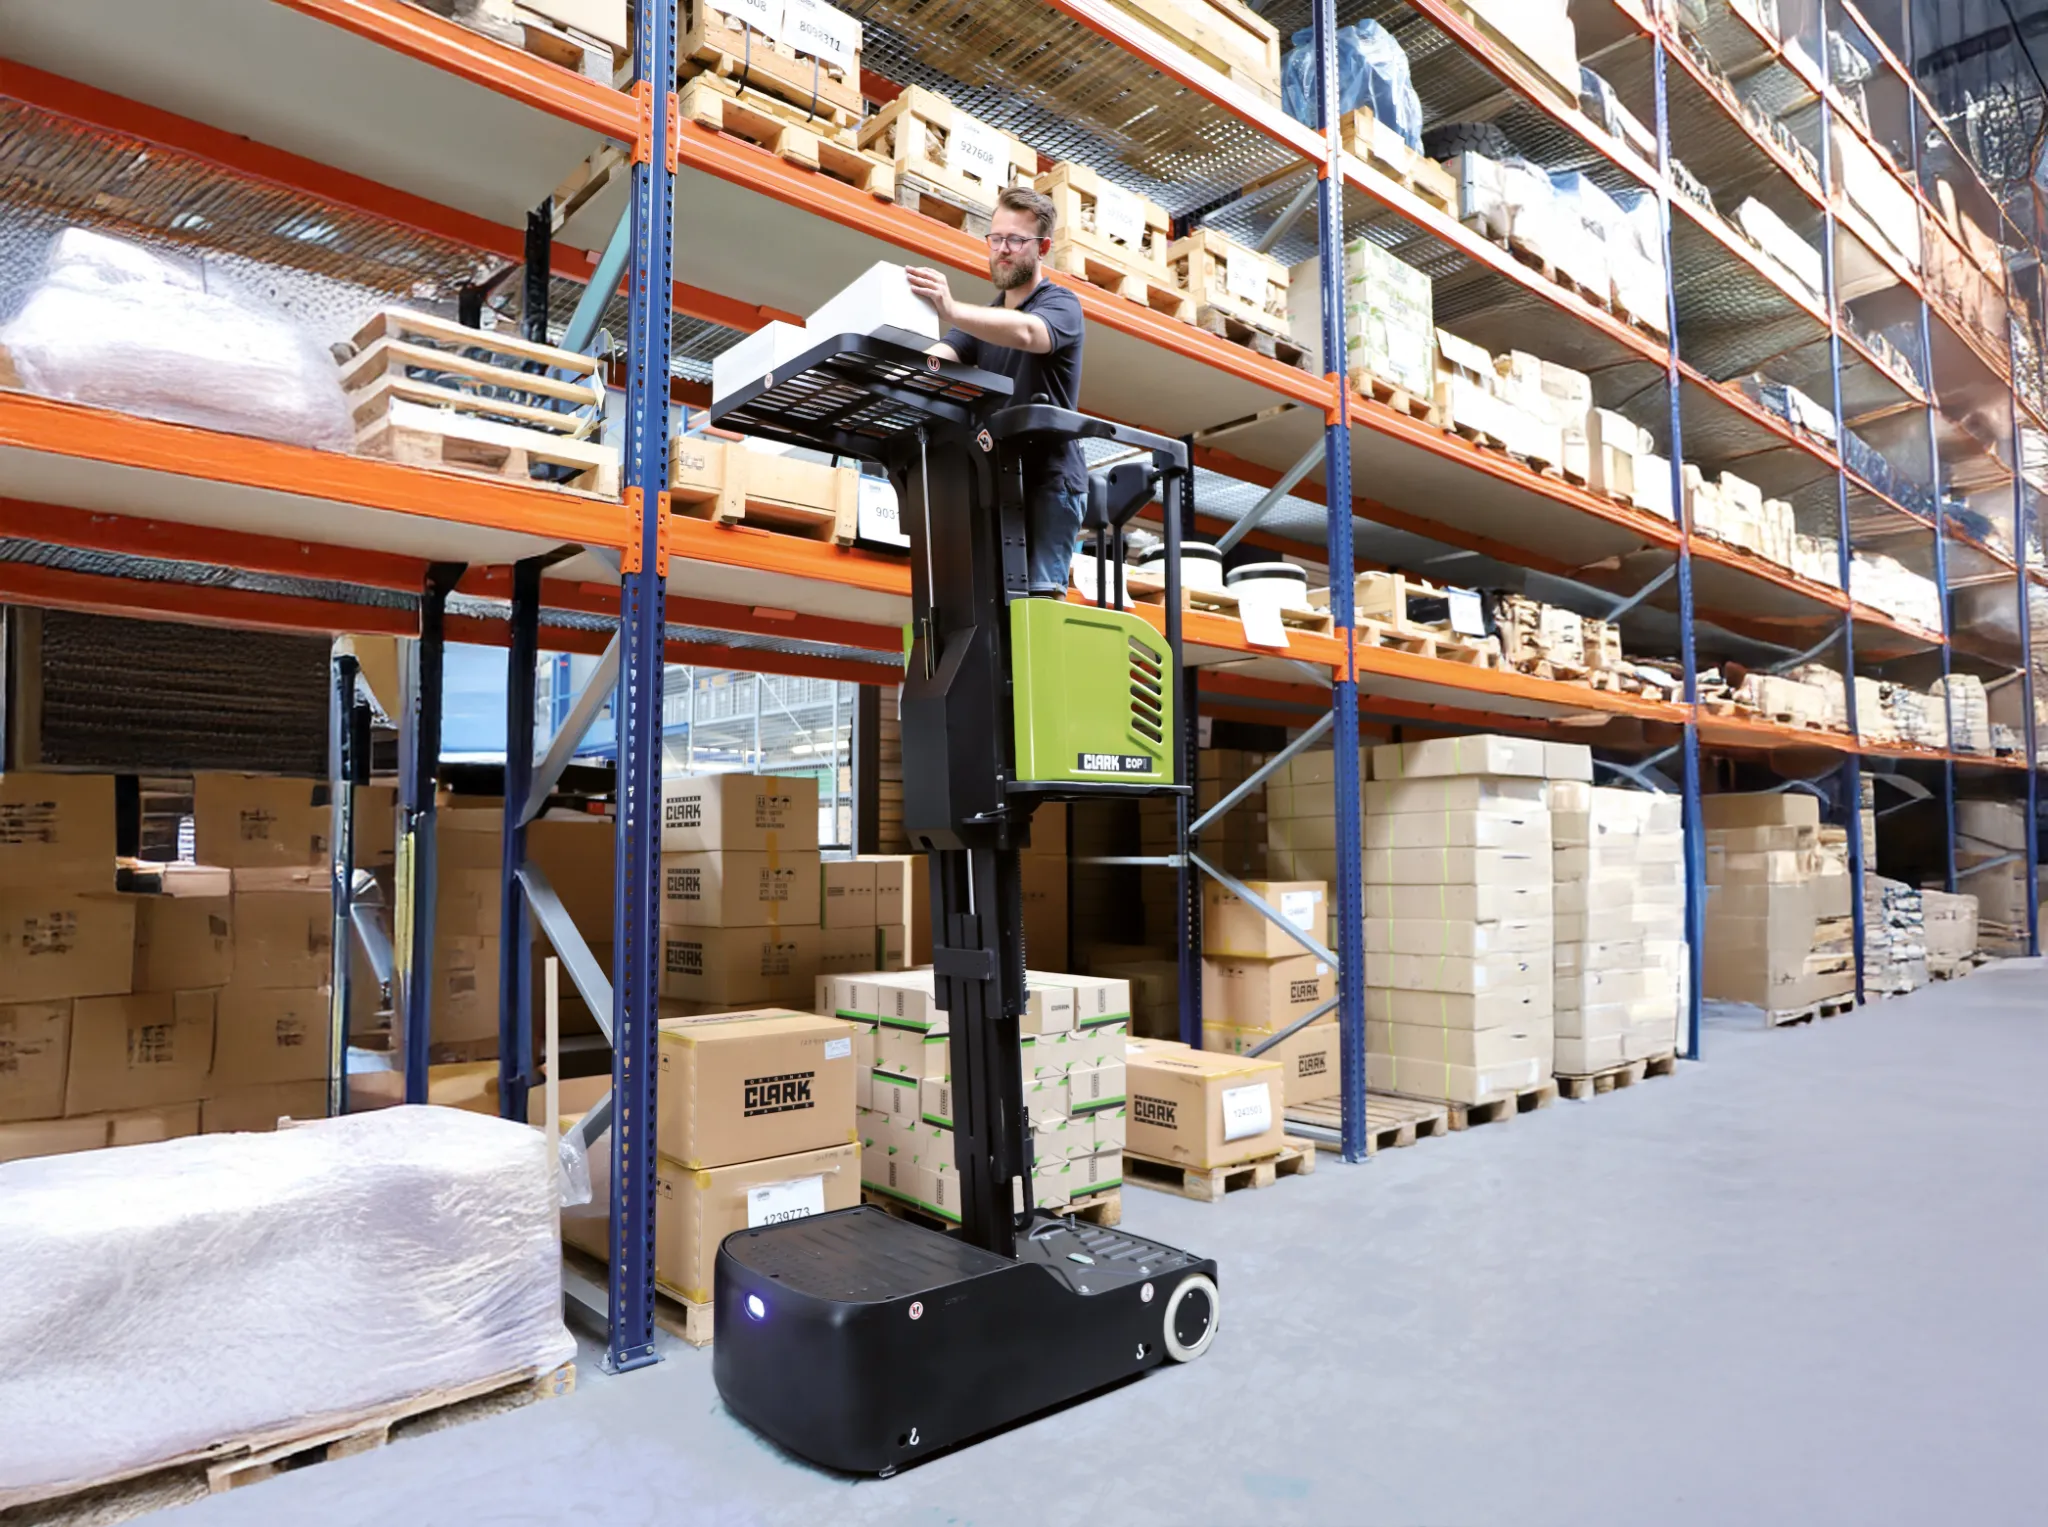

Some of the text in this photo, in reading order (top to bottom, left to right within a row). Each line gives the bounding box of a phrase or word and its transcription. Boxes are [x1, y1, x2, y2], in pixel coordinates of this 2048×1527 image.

[960, 140, 994, 164] 927608
[875, 506, 900, 520] 903
[1083, 754, 1120, 771] CLARK
[666, 804, 701, 820] CLARK
[667, 877, 700, 892] CLARK
[667, 949, 702, 967] CLARK
[1290, 984, 1318, 999] CLARK
[1299, 1057, 1326, 1073] CLARK
[750, 1073, 809, 1084] ORIGINAL
[745, 1080, 811, 1109] CLARK
[750, 1104, 809, 1116] PARTS
[1134, 1100, 1175, 1123] CLARK
[764, 1207, 810, 1226] 1239773
